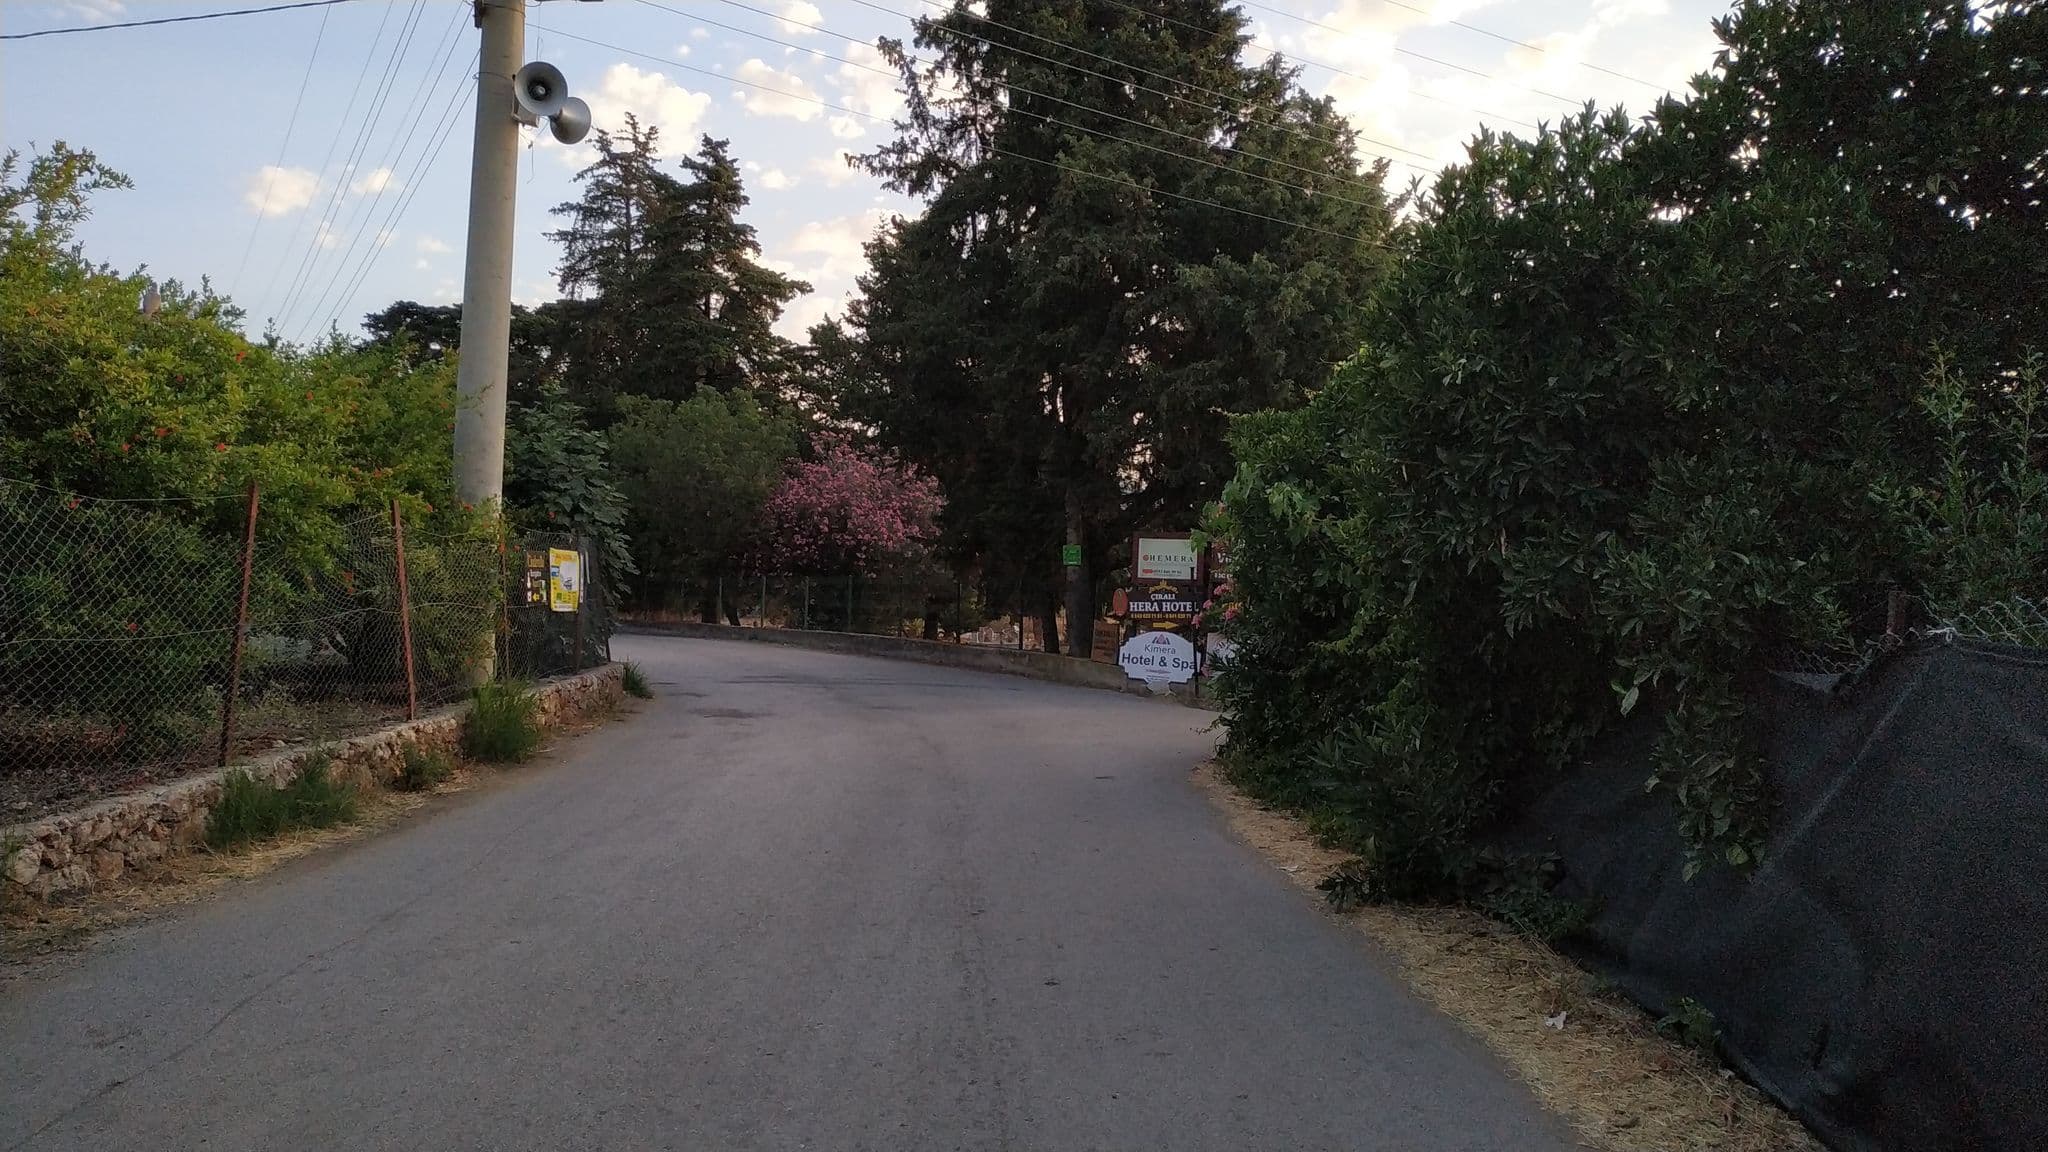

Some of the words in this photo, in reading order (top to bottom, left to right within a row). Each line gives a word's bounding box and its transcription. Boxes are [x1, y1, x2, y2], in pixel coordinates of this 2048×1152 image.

[1129, 601, 1160, 612] HERA
[1161, 601, 1200, 612] HOTEL
[1144, 644, 1176, 655] Kimera
[1121, 652, 1155, 666] Hotel
[1158, 655, 1168, 667] &
[1171, 657, 1196, 671] Spa
